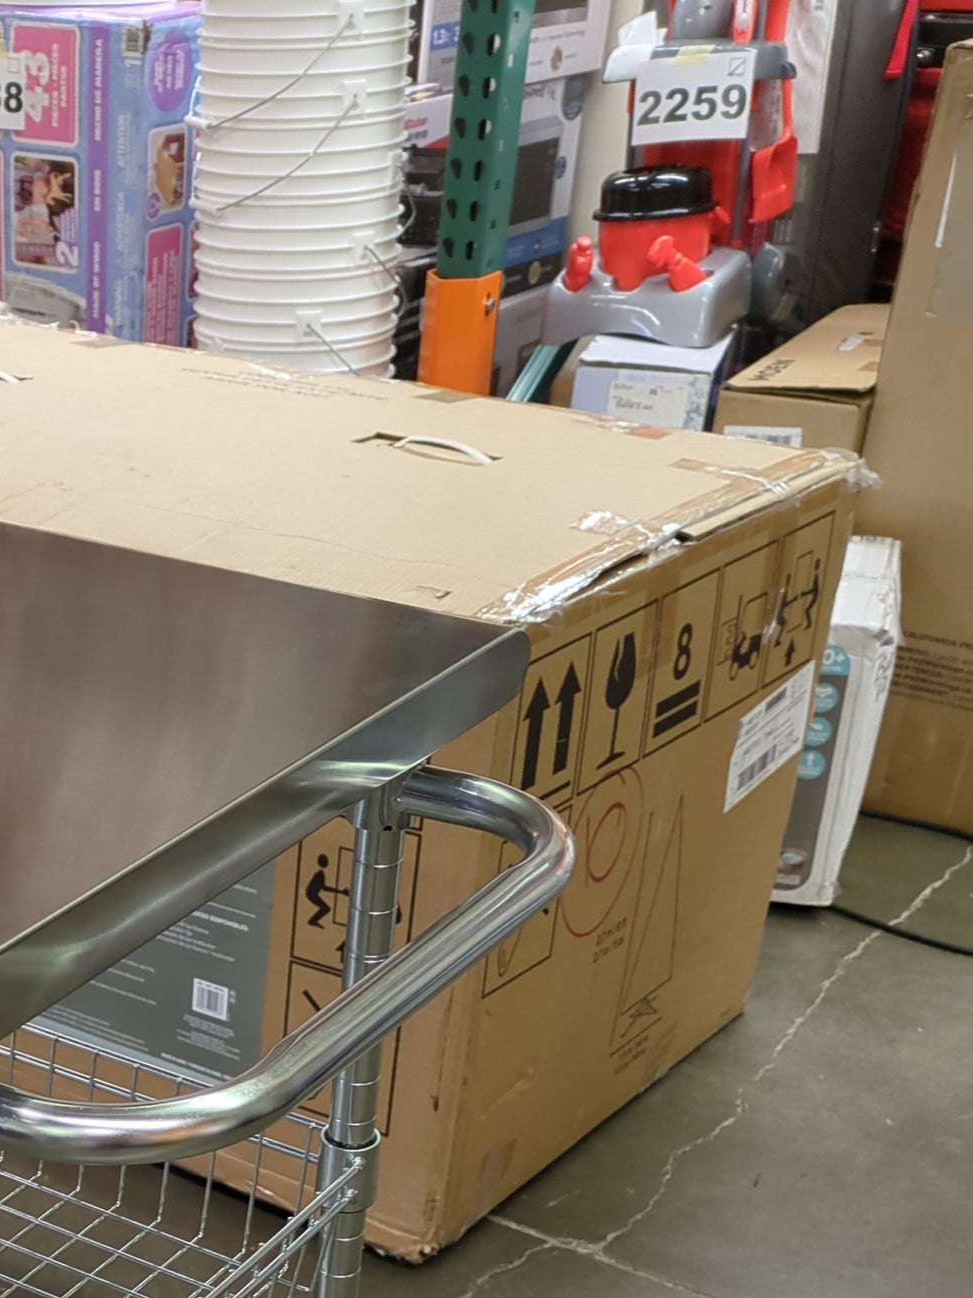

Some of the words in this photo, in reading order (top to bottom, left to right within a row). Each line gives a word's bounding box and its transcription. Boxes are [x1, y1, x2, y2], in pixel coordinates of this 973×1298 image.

[94, 39, 103, 88] MADERA
[20, 49, 50, 123] 43
[94, 89, 102, 104] DE
[638, 84, 747, 126] 2259
[94, 106, 102, 141] HECHO
[56, 244, 78, 268] 2
[92, 241, 101, 274] WOOD
[673, 622, 694, 681] 8
